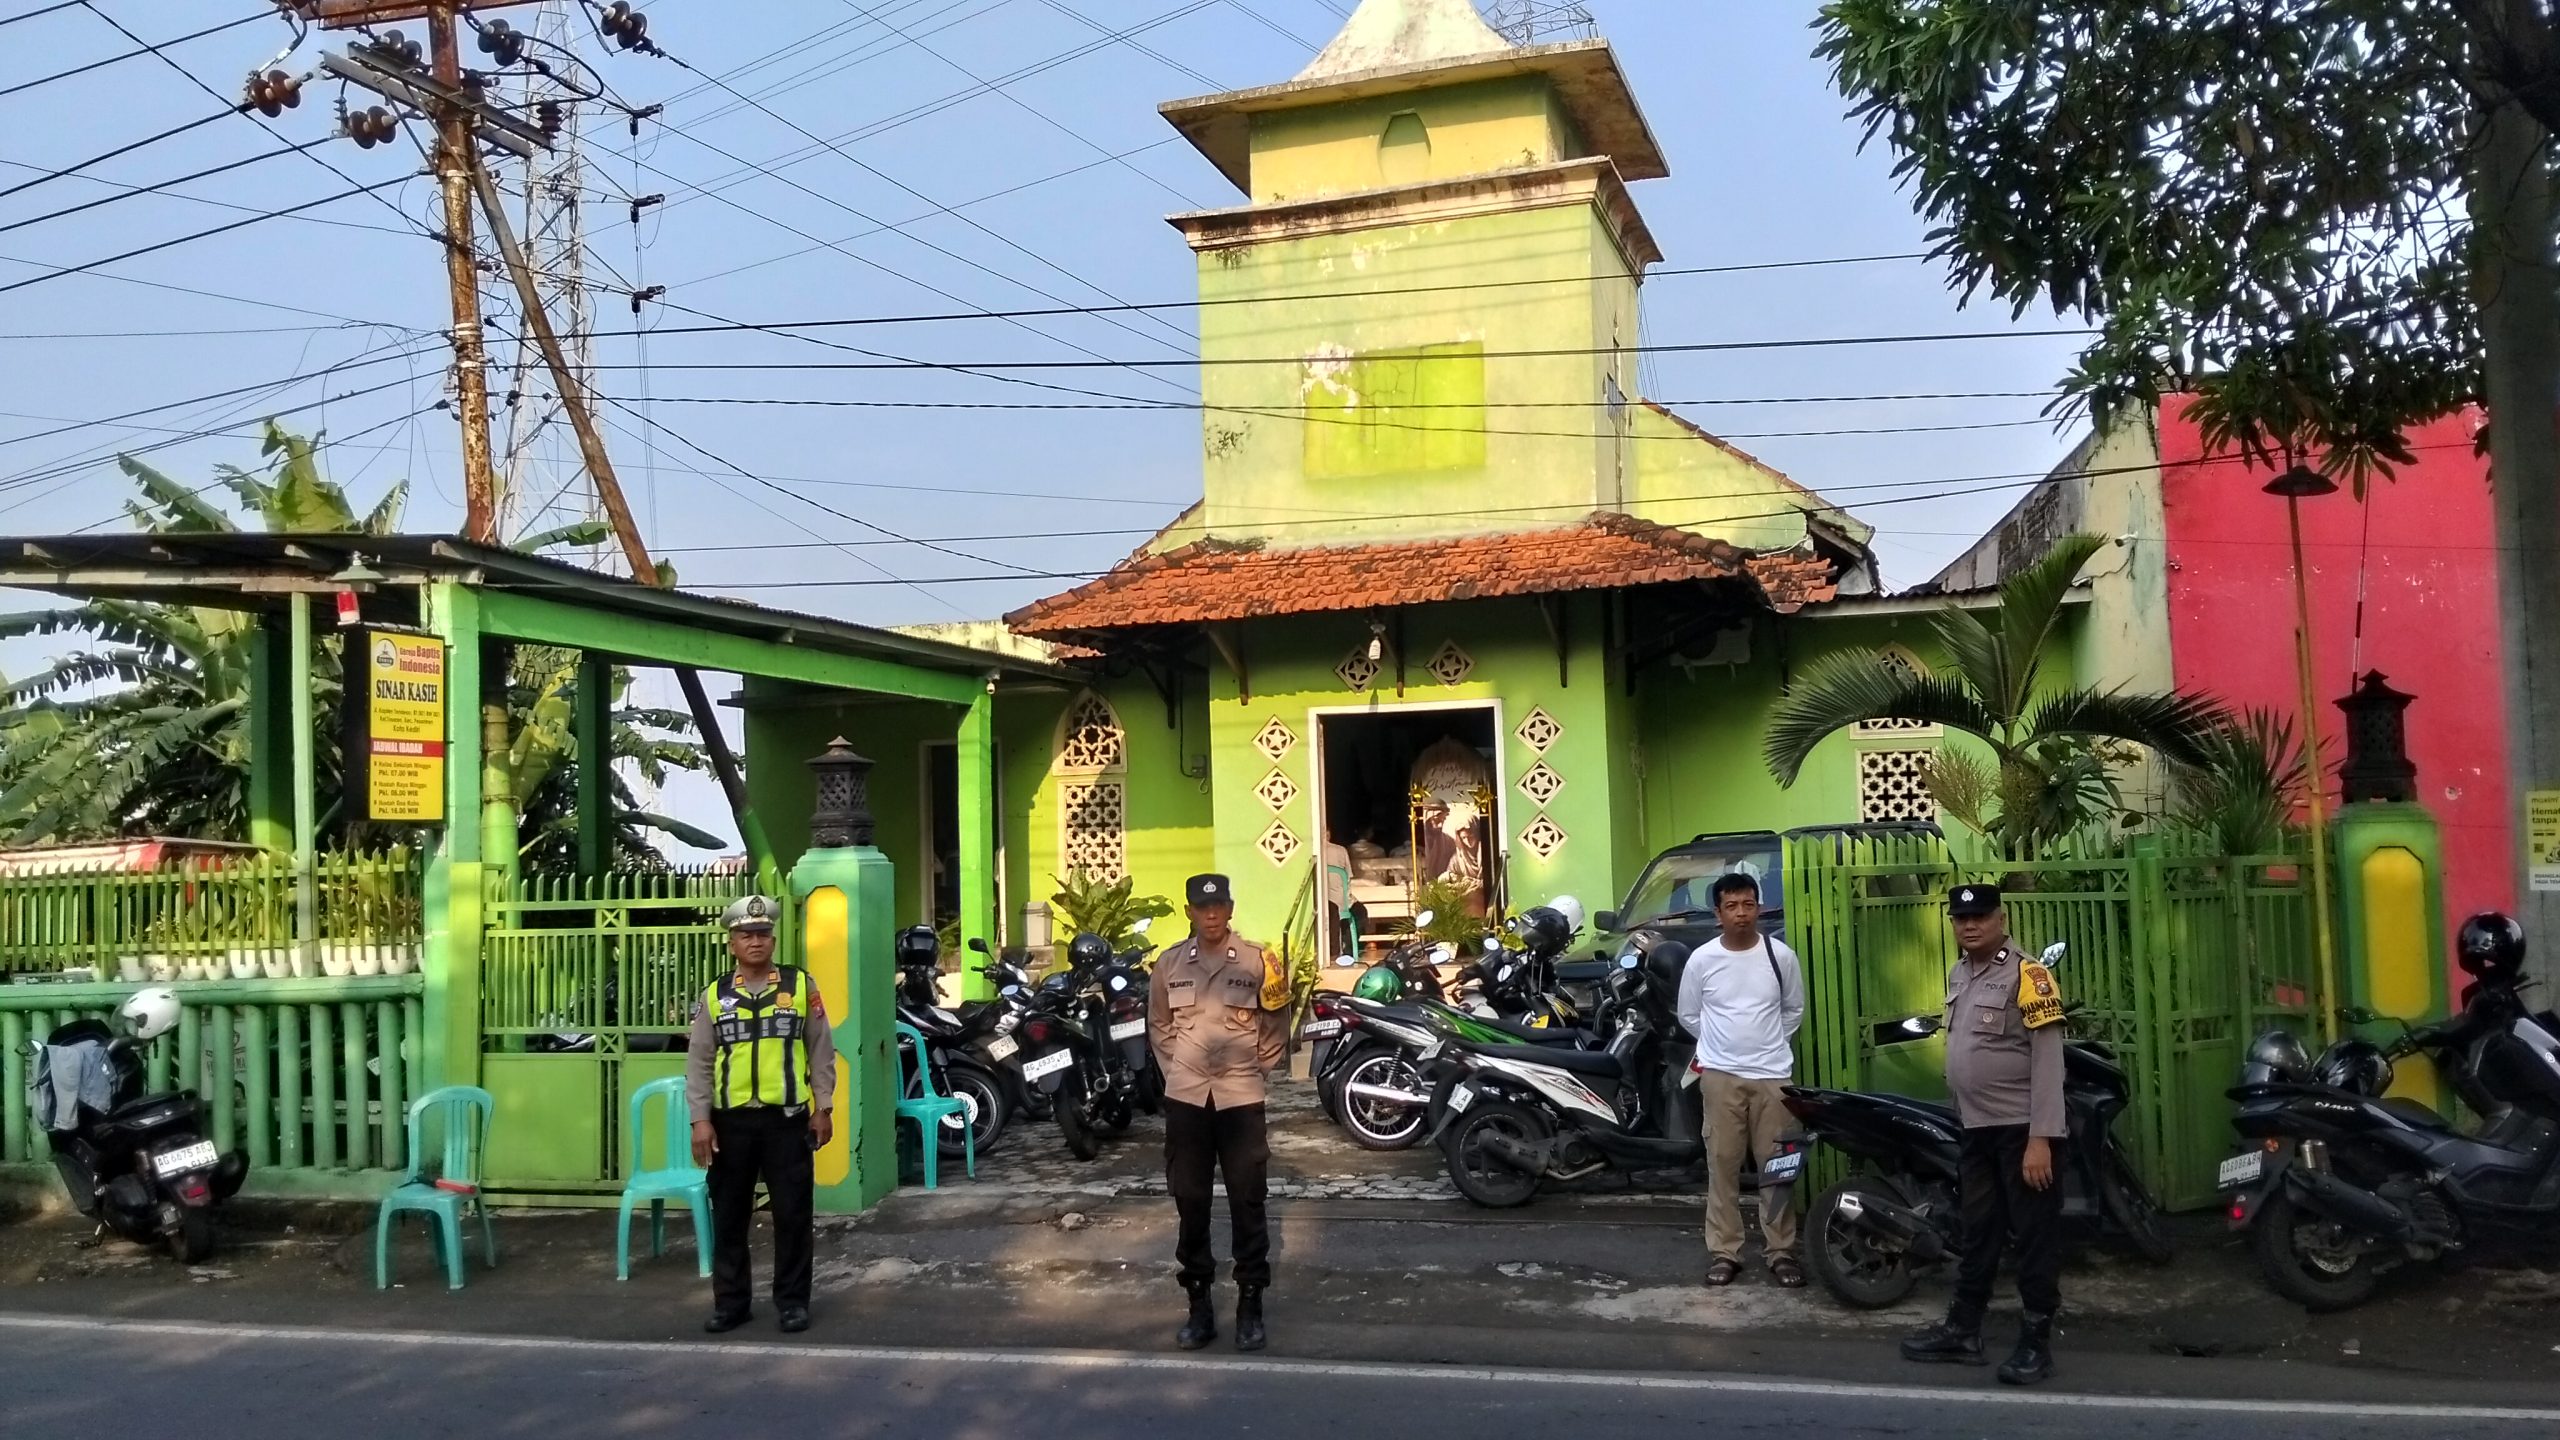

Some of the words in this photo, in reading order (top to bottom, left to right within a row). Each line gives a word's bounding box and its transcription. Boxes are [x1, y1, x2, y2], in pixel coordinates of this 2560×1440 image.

[416, 645, 441, 660] Baptis
[399, 658, 441, 675] Indonesia
[375, 679, 406, 701] SINAR
[407, 681, 438, 703] KASIH
[1984, 983, 2008, 991] POLRI
[157, 1155, 170, 1166] AG
